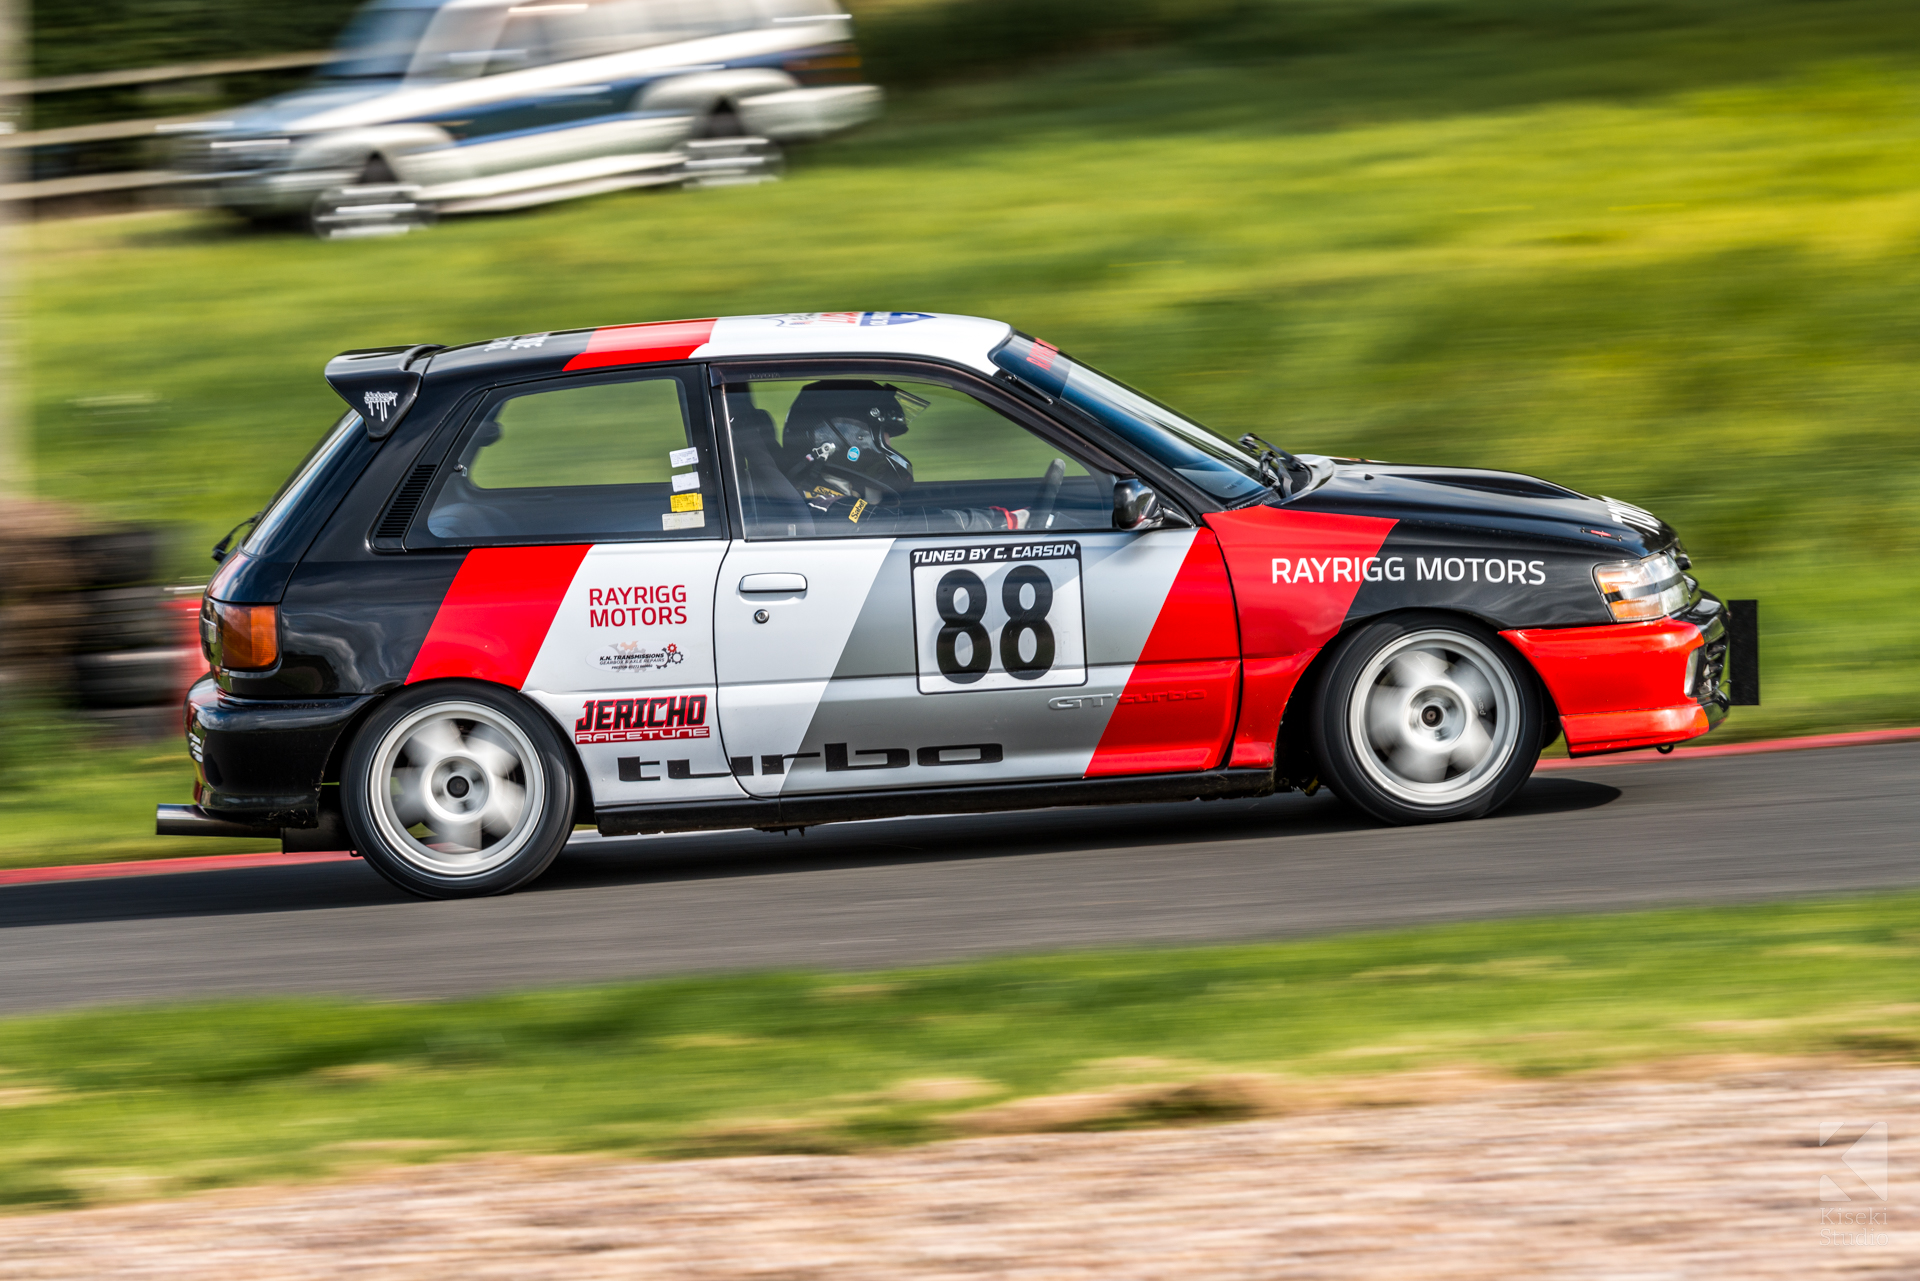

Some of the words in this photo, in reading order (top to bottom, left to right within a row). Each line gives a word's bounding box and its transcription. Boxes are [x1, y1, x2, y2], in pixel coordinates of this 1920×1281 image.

[913, 549, 966, 563] TUNED
[969, 548, 991, 561] BY
[993, 547, 1008, 560] C.
[1011, 543, 1077, 559] CARSON
[1271, 556, 1405, 584] RAYRIGG
[1416, 557, 1546, 585] MOTORS
[589, 584, 687, 606] RAYRIGG
[590, 606, 688, 628] MOTORS
[936, 564, 1056, 684] 88
[1048, 693, 1114, 710] GT
[1117, 689, 1208, 705] turbo
[575, 694, 708, 732] JERICHO
[576, 727, 710, 743] RACETUNE
[617, 743, 1003, 782] turbo
